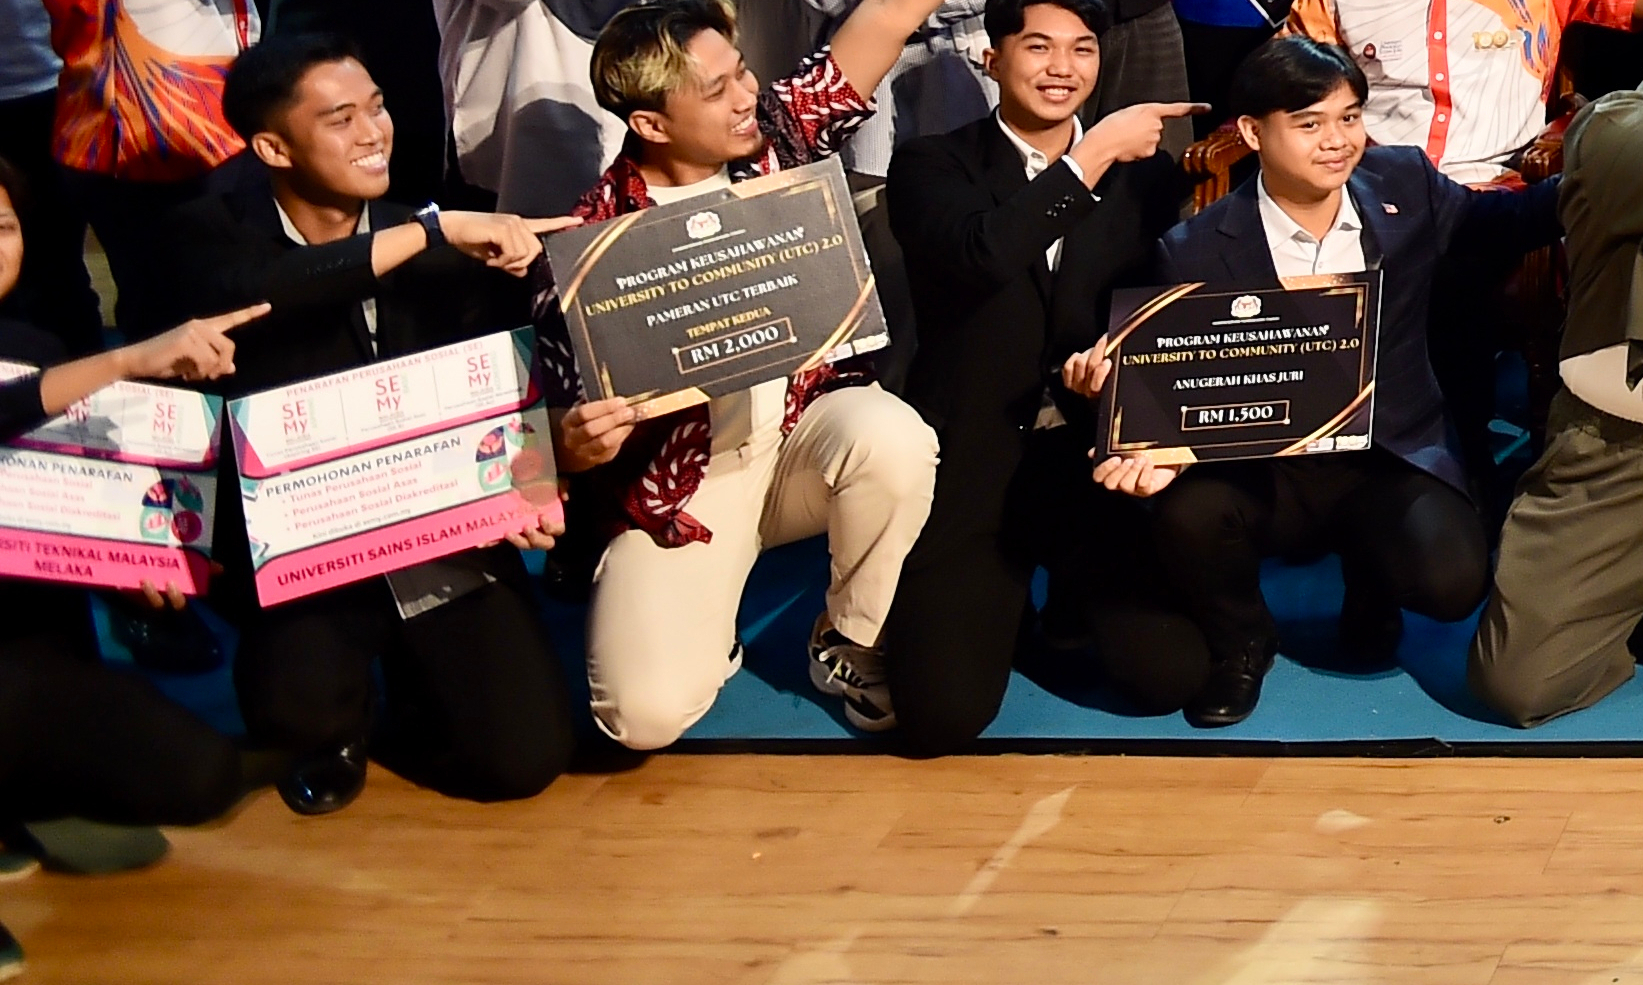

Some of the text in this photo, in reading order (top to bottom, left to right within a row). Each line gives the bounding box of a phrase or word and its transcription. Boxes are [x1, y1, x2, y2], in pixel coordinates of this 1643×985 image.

[585, 234, 844, 316] UNIVERSITY TO COMMUNITY (UTC) 2.0
[646, 274, 799, 327] PAMERAN UTC TERBAIK
[686, 306, 772, 339] TEMPAT KEDUA
[690, 326, 780, 364] RM 2,000
[1123, 338, 1360, 366] UNIVERSITY TO COMMUNITY (UTC) 2.0
[1173, 370, 1304, 390] ANUGERAH KHAS JURI
[1199, 405, 1274, 423] RM 1,500
[52, 463, 133, 482] PENARAFAN
[265, 436, 462, 498] PERMOHONAN PENARAFAN
[34, 560, 93, 577] MELAKA
[35, 540, 180, 570] TEKNIKAL MALAYSIA
[277, 554, 364, 587] UNIVERSITI
[367, 539, 413, 563] SAINS
[416, 525, 462, 548] ISLAM
